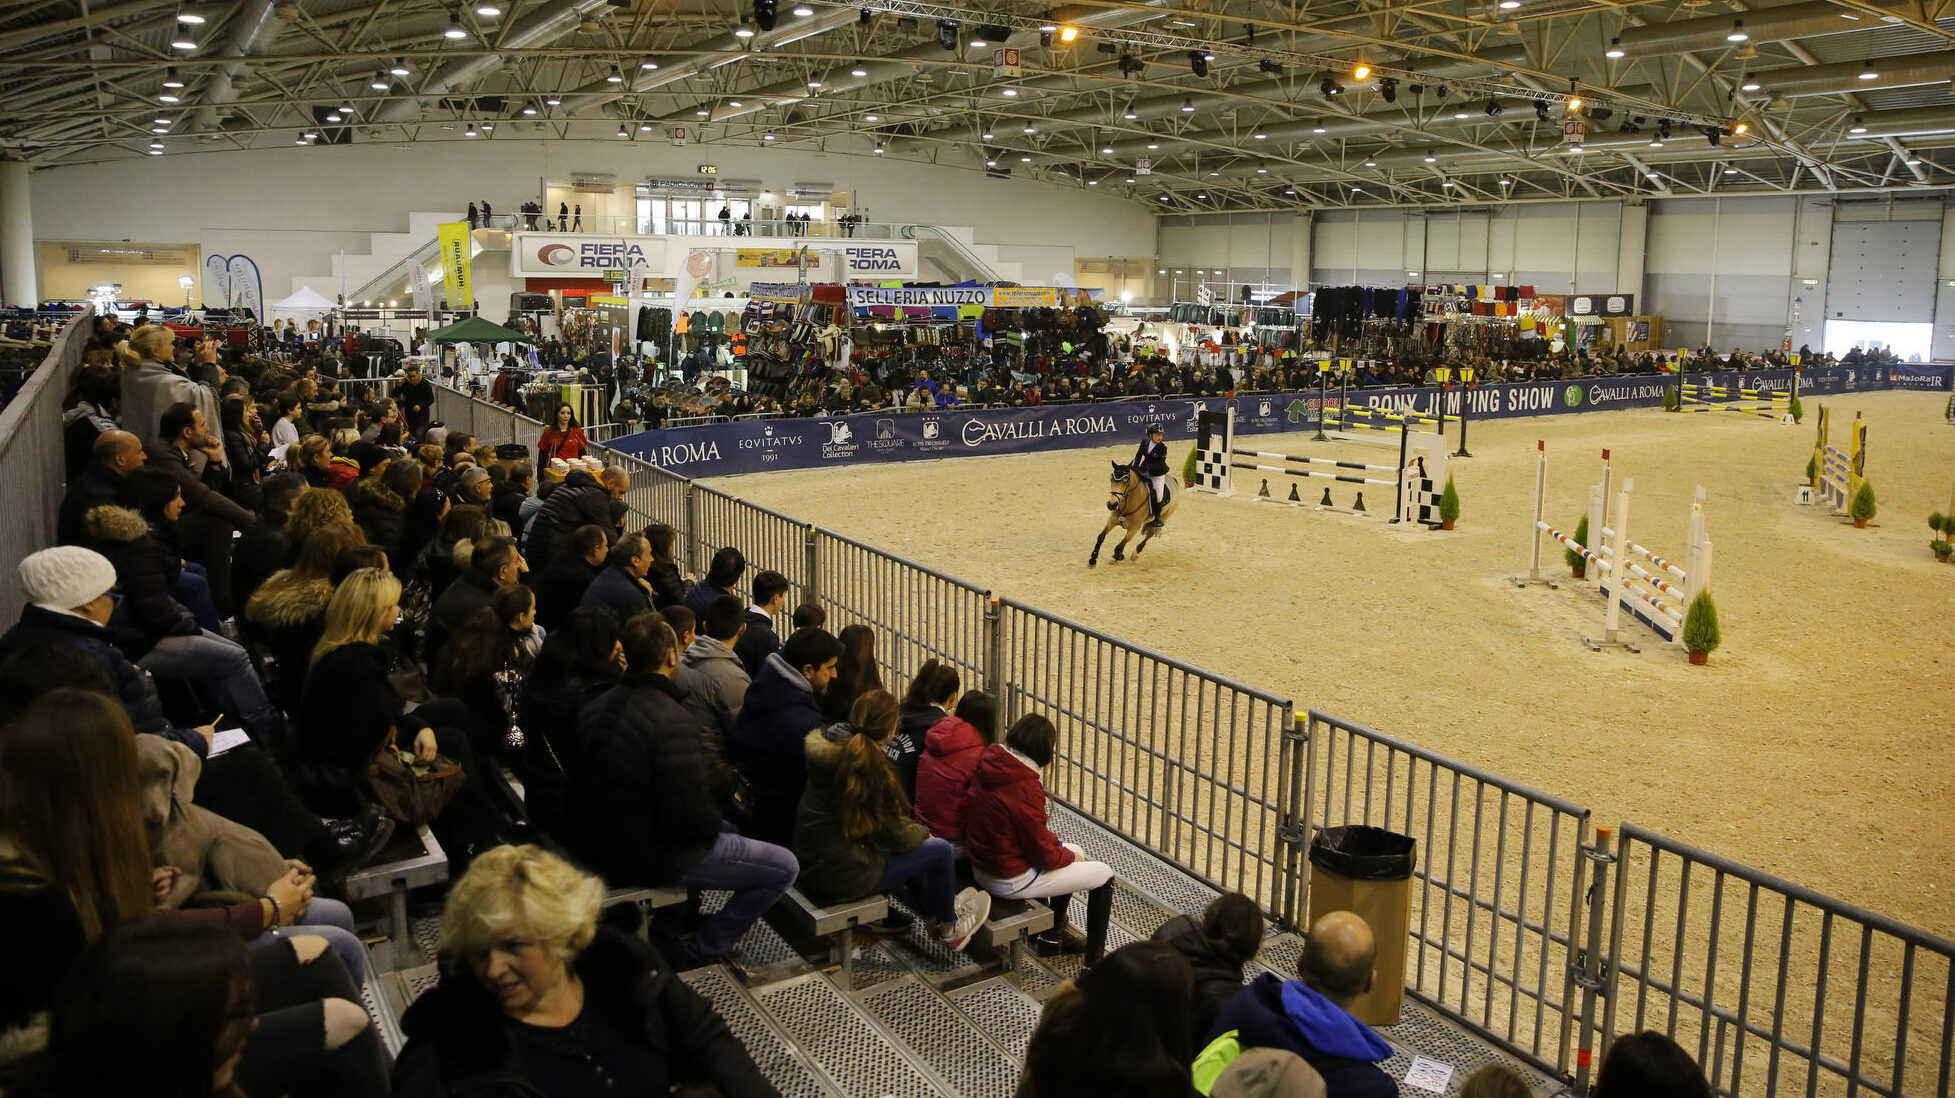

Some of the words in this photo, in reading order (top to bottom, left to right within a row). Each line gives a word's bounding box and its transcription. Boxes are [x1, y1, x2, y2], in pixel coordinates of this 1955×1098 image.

[581, 243, 643, 256] FIERA
[846, 247, 897, 258] FIERA
[850, 259, 901, 270] ROMA
[856, 290, 929, 304] SELLERIA
[932, 290, 986, 304] NUZZO
[1752, 377, 1785, 391] CAVALLI
[1589, 385, 1630, 405] CAVALLI
[1631, 387, 1638, 399] A
[1640, 385, 1665, 398] ROMA
[1369, 394, 1418, 419] PONY
[1508, 387, 1554, 411] SHOW
[1128, 413, 1176, 424] EQVITATVS
[962, 418, 1044, 447] CAVALLI
[1049, 419, 1063, 437] A
[1066, 415, 1117, 435] ROMA
[739, 435, 802, 449] EQVITATVS
[650, 448, 658, 467] A
[661, 440, 722, 467] ROMA
[762, 454, 778, 462] 1991
[823, 451, 853, 459] Collection
